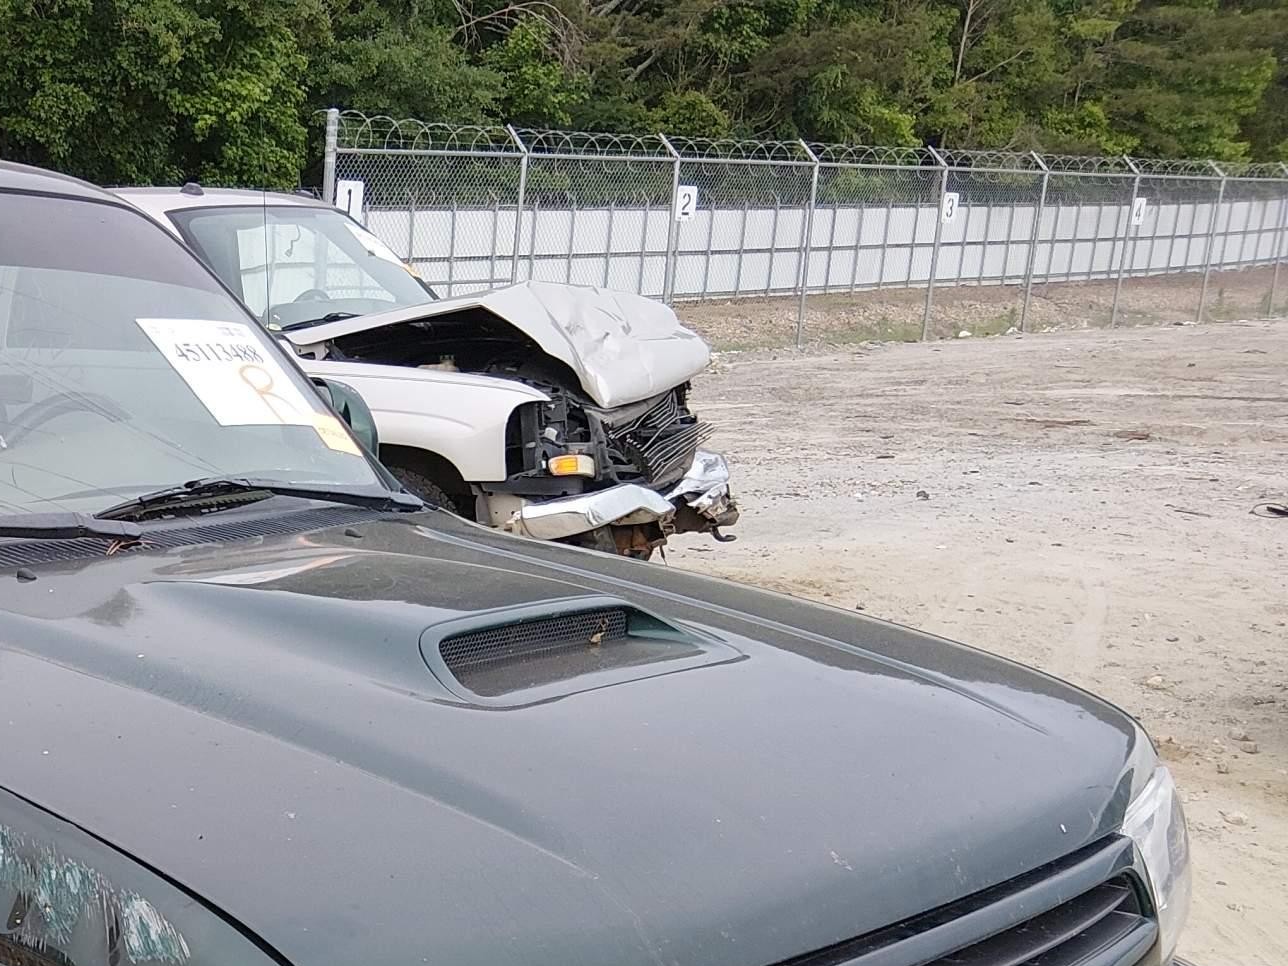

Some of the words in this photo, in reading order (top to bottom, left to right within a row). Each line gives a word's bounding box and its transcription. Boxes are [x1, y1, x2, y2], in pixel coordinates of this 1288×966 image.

[346, 188, 353, 215] 1
[681, 193, 692, 216] 2
[945, 198, 955, 218] 3
[1134, 202, 1142, 221] 4
[174, 343, 264, 363] 45113488
[238, 364, 299, 424] R
